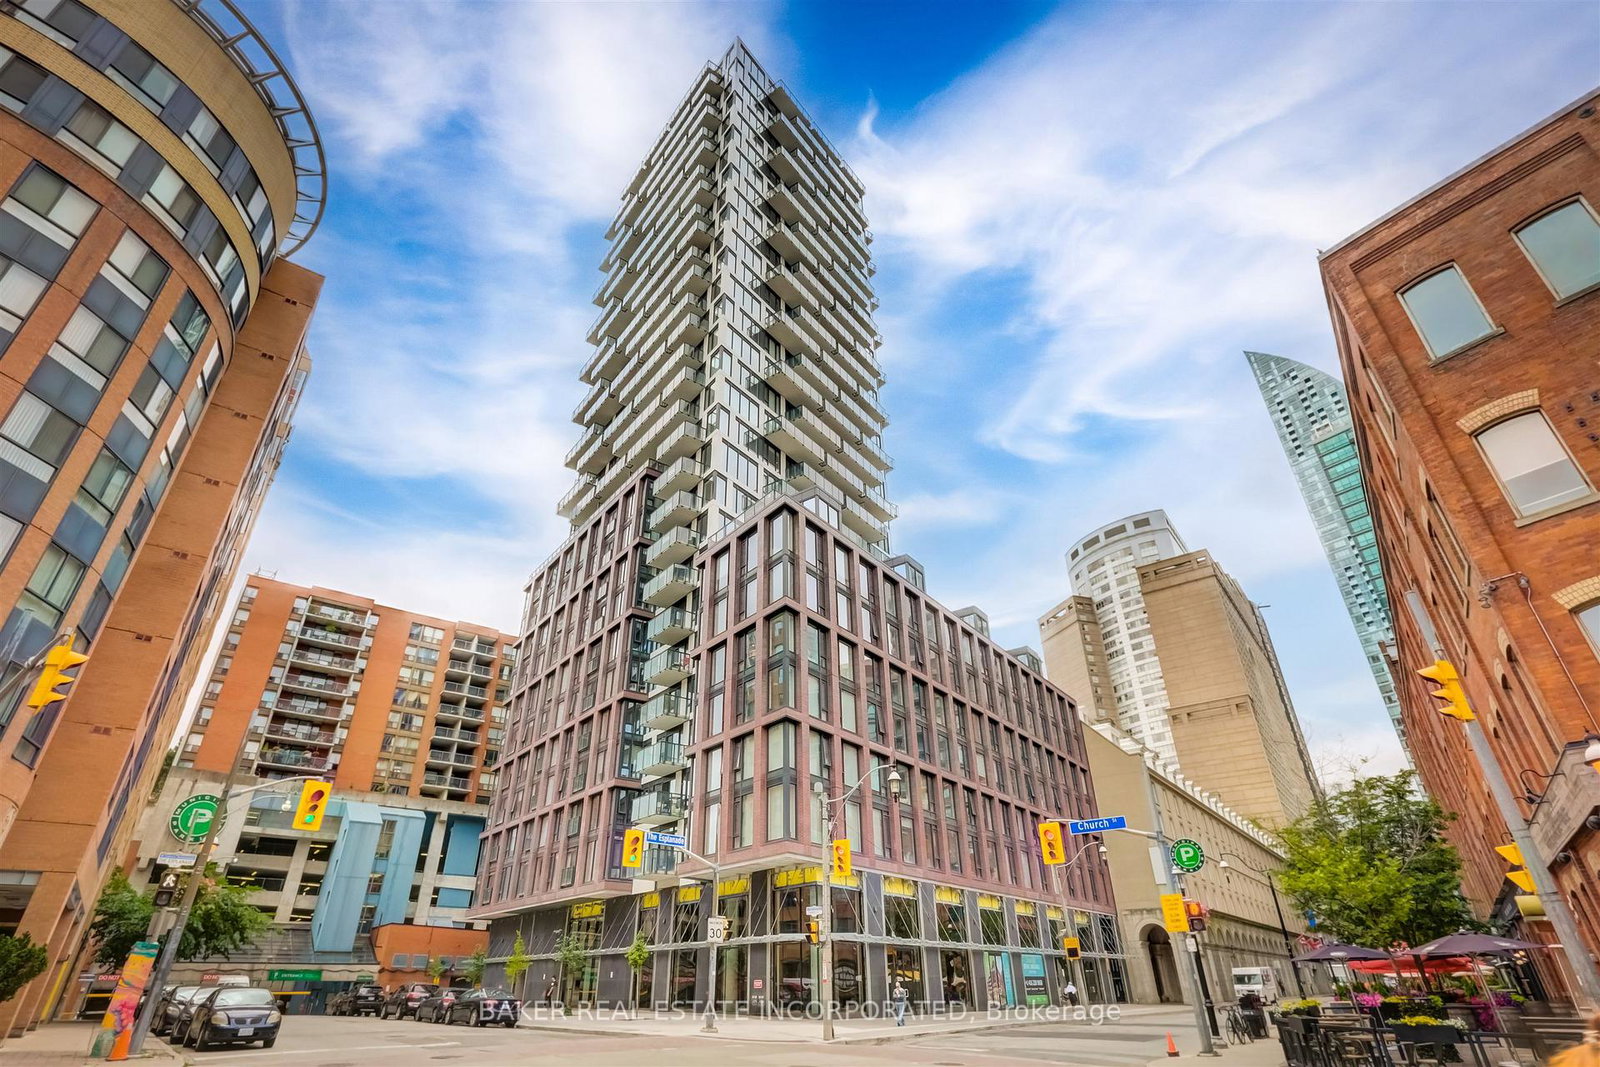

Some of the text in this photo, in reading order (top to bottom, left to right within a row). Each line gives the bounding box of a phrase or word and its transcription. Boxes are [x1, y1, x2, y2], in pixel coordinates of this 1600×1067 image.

[1078, 820, 1109, 830] Church
[647, 831, 684, 844] The Esplanade
[709, 928, 721, 939] 30
